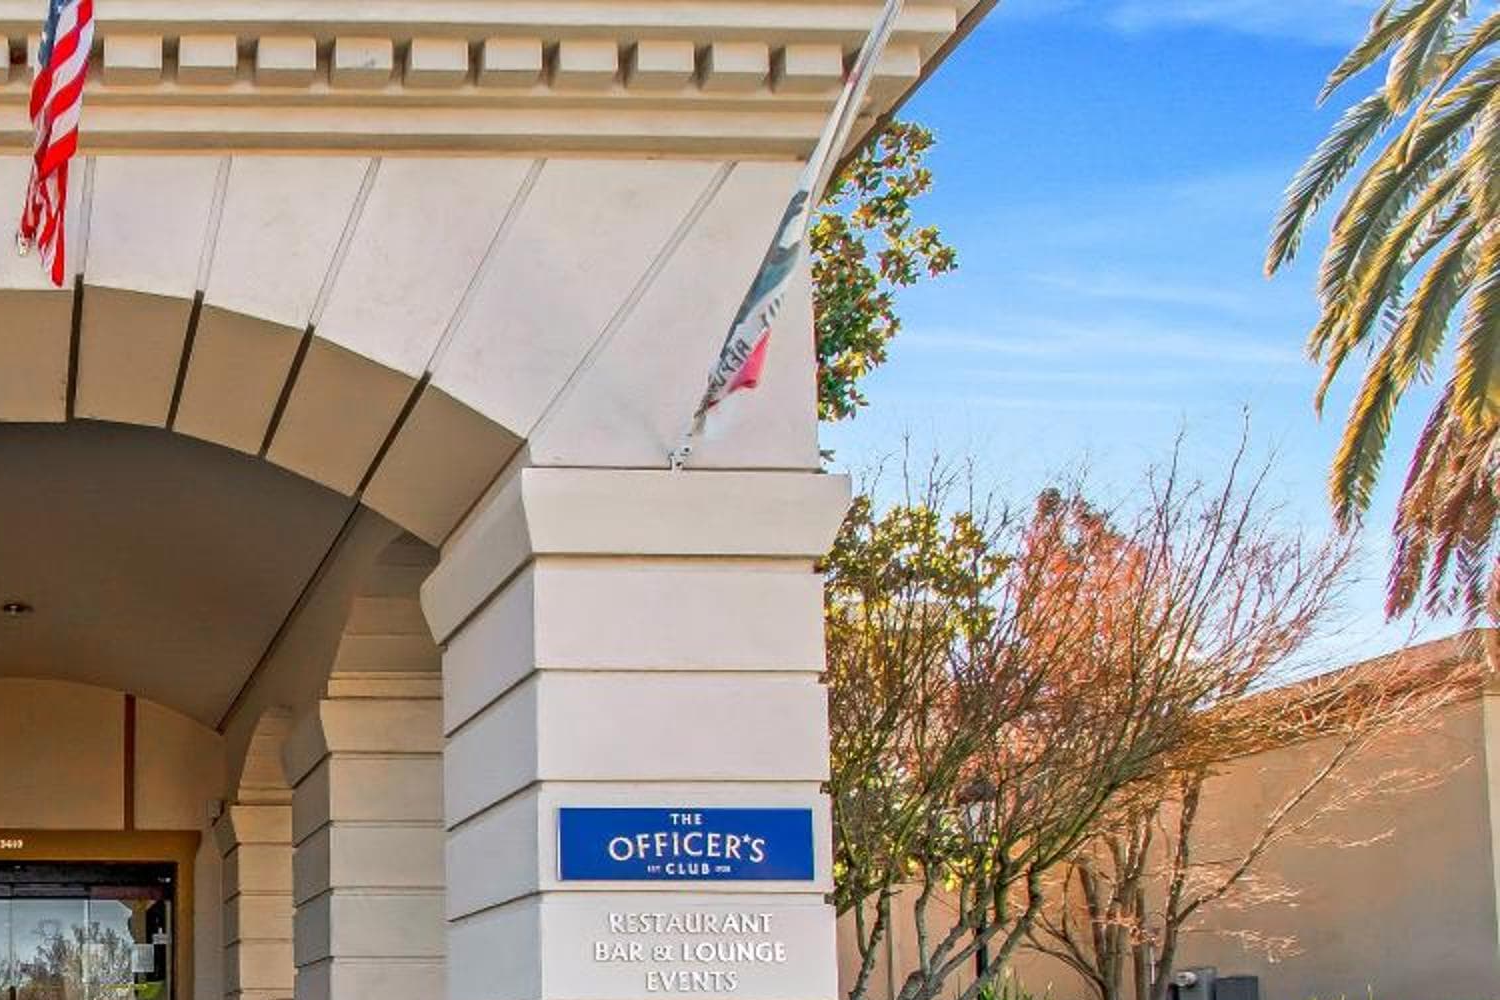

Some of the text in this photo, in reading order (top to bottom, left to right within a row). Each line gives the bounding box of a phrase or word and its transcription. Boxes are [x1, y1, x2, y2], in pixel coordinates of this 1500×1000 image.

[670, 813, 703, 825] THE
[665, 863, 710, 875] CLUB
[608, 912, 774, 934] RESTAURANT
[594, 941, 788, 963] BAR & LOUNGE
[646, 970, 739, 992] EVENTS
